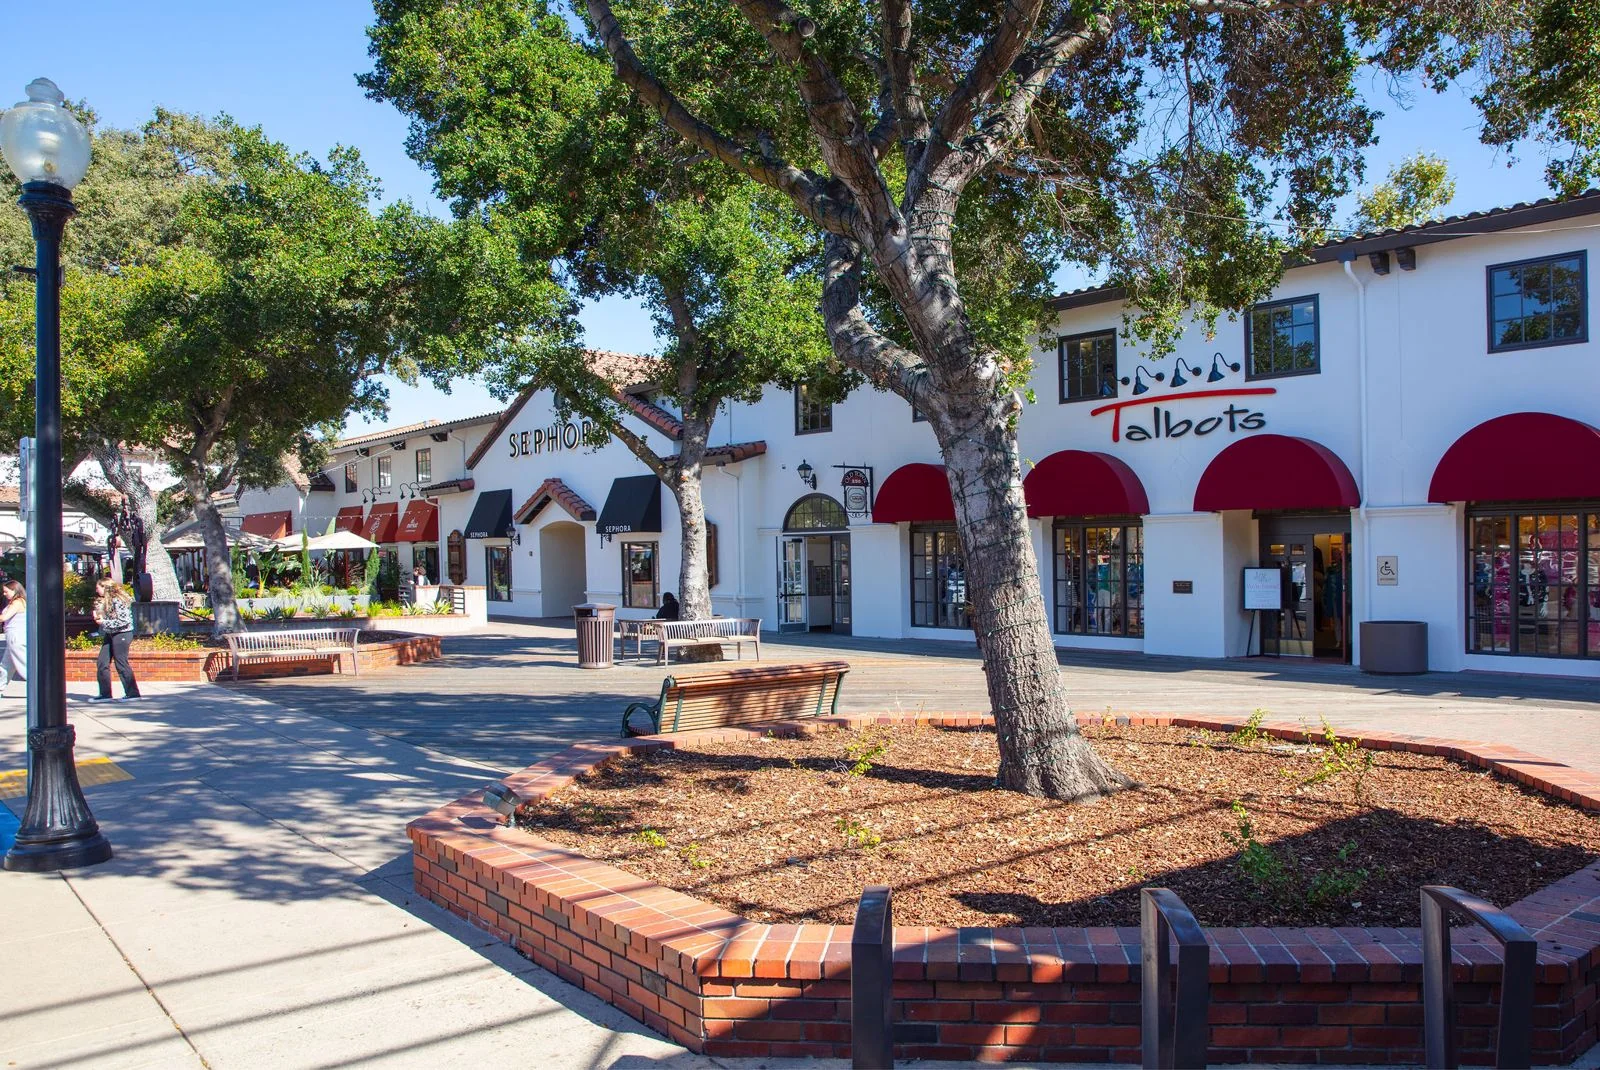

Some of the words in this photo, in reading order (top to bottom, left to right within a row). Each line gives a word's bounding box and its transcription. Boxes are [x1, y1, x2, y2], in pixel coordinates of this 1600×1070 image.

[1091, 387, 1276, 443] Talbots
[509, 421, 612, 458] SEPHOR
[605, 525, 631, 533] SEPHORA
